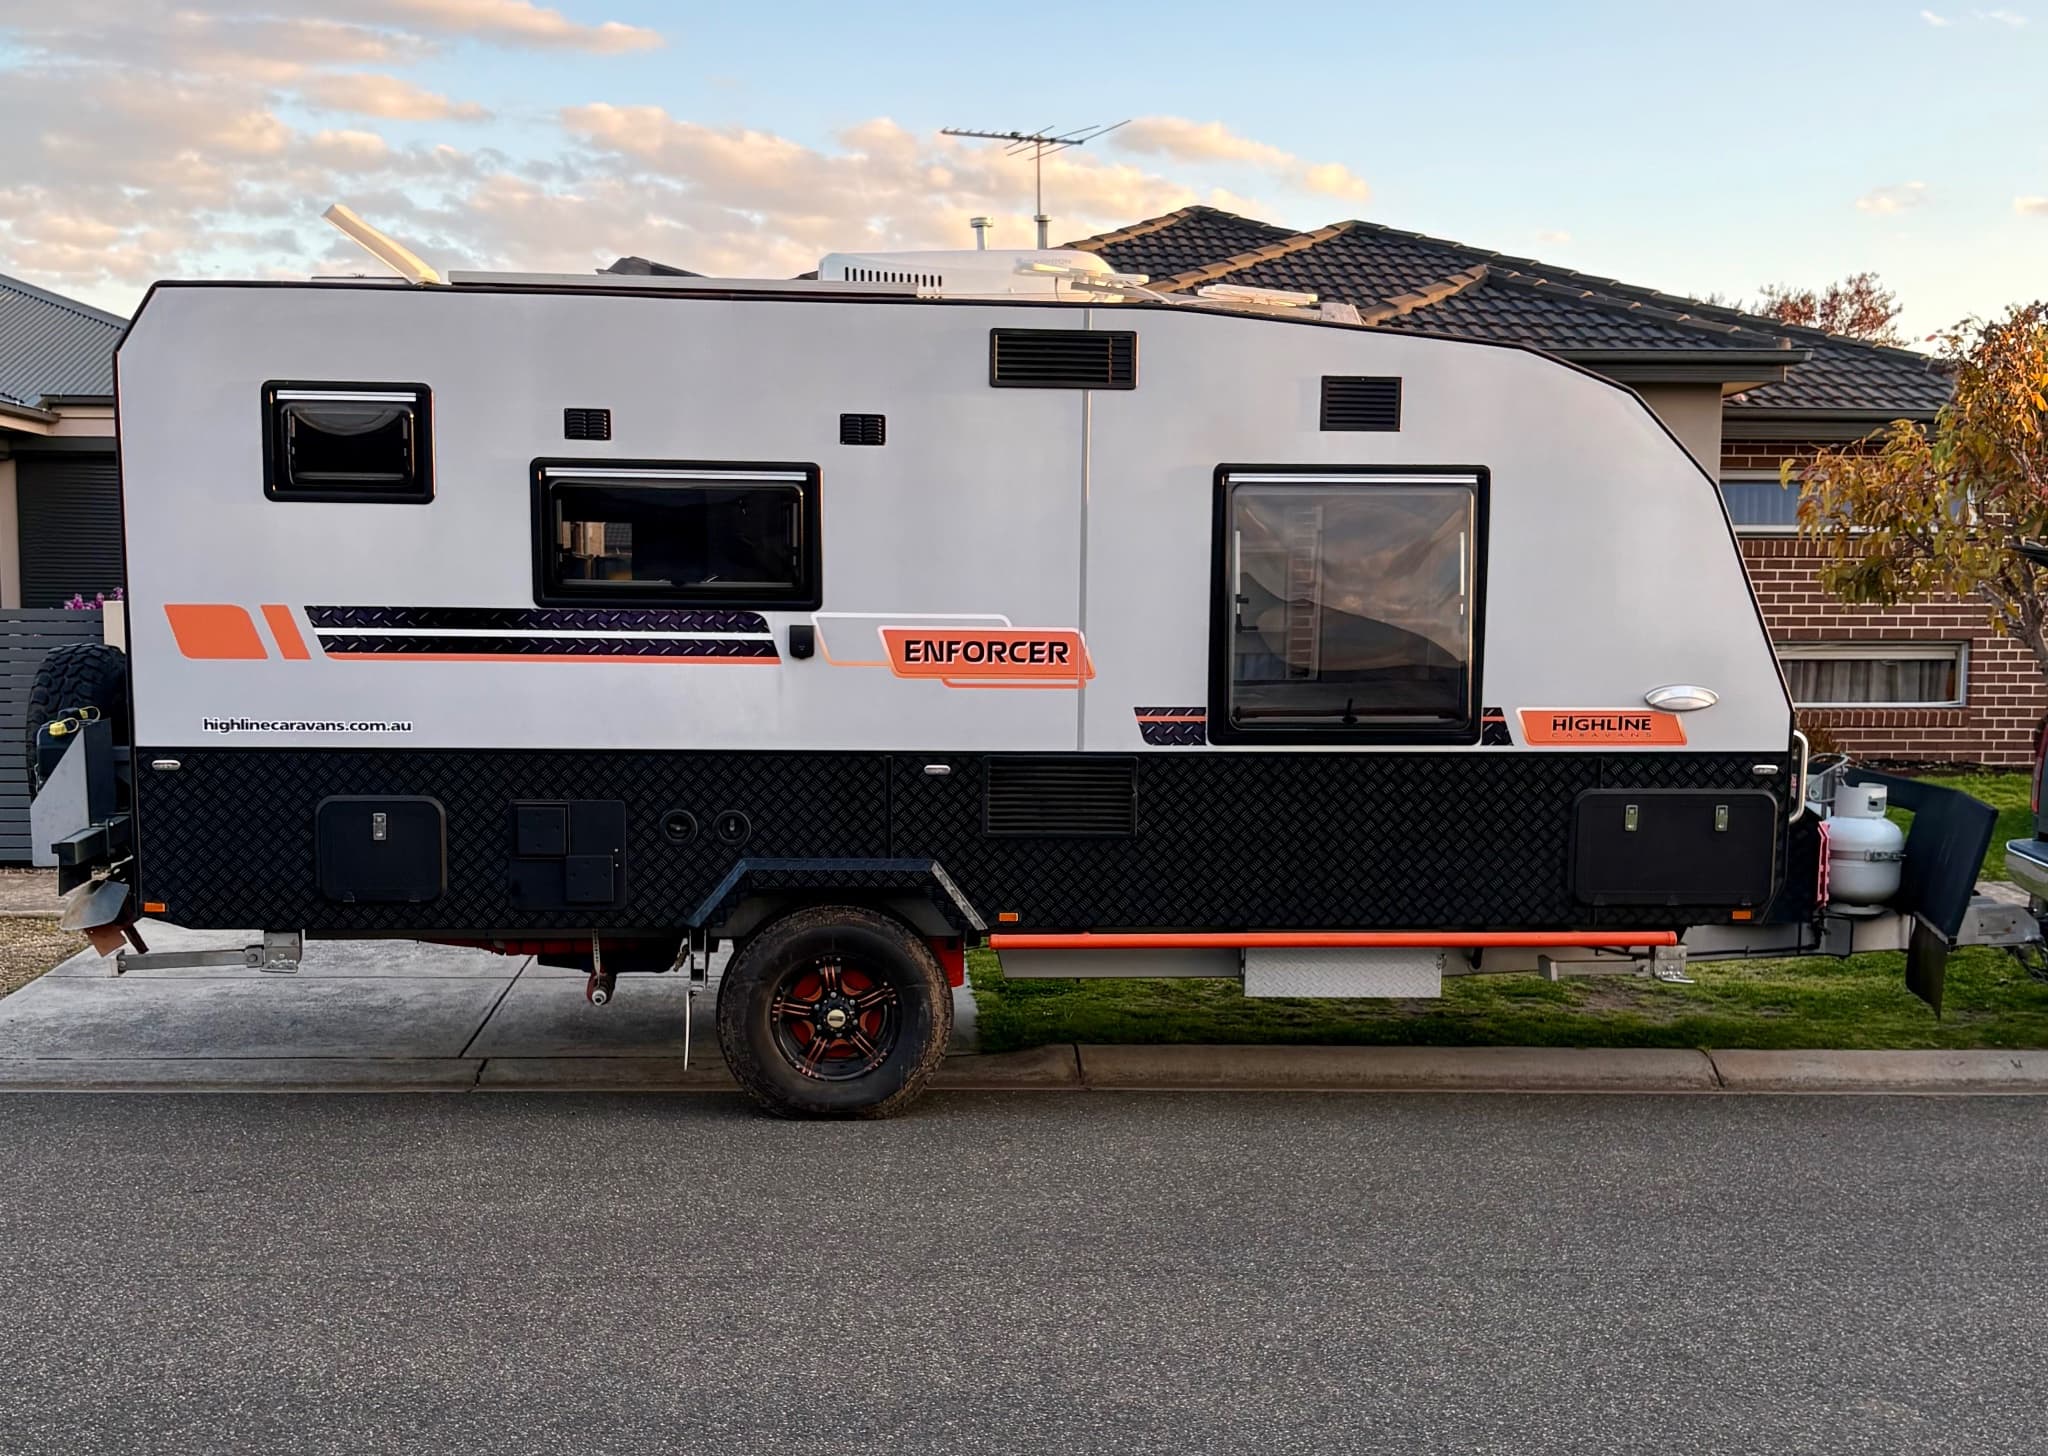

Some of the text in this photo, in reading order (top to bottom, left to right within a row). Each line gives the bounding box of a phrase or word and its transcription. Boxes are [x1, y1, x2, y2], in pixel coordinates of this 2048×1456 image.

[904, 640, 1070, 664] ENFORCER
[203, 718, 412, 733] highlinecaravans.com.au
[1552, 716, 1652, 731] HIGHLINE
